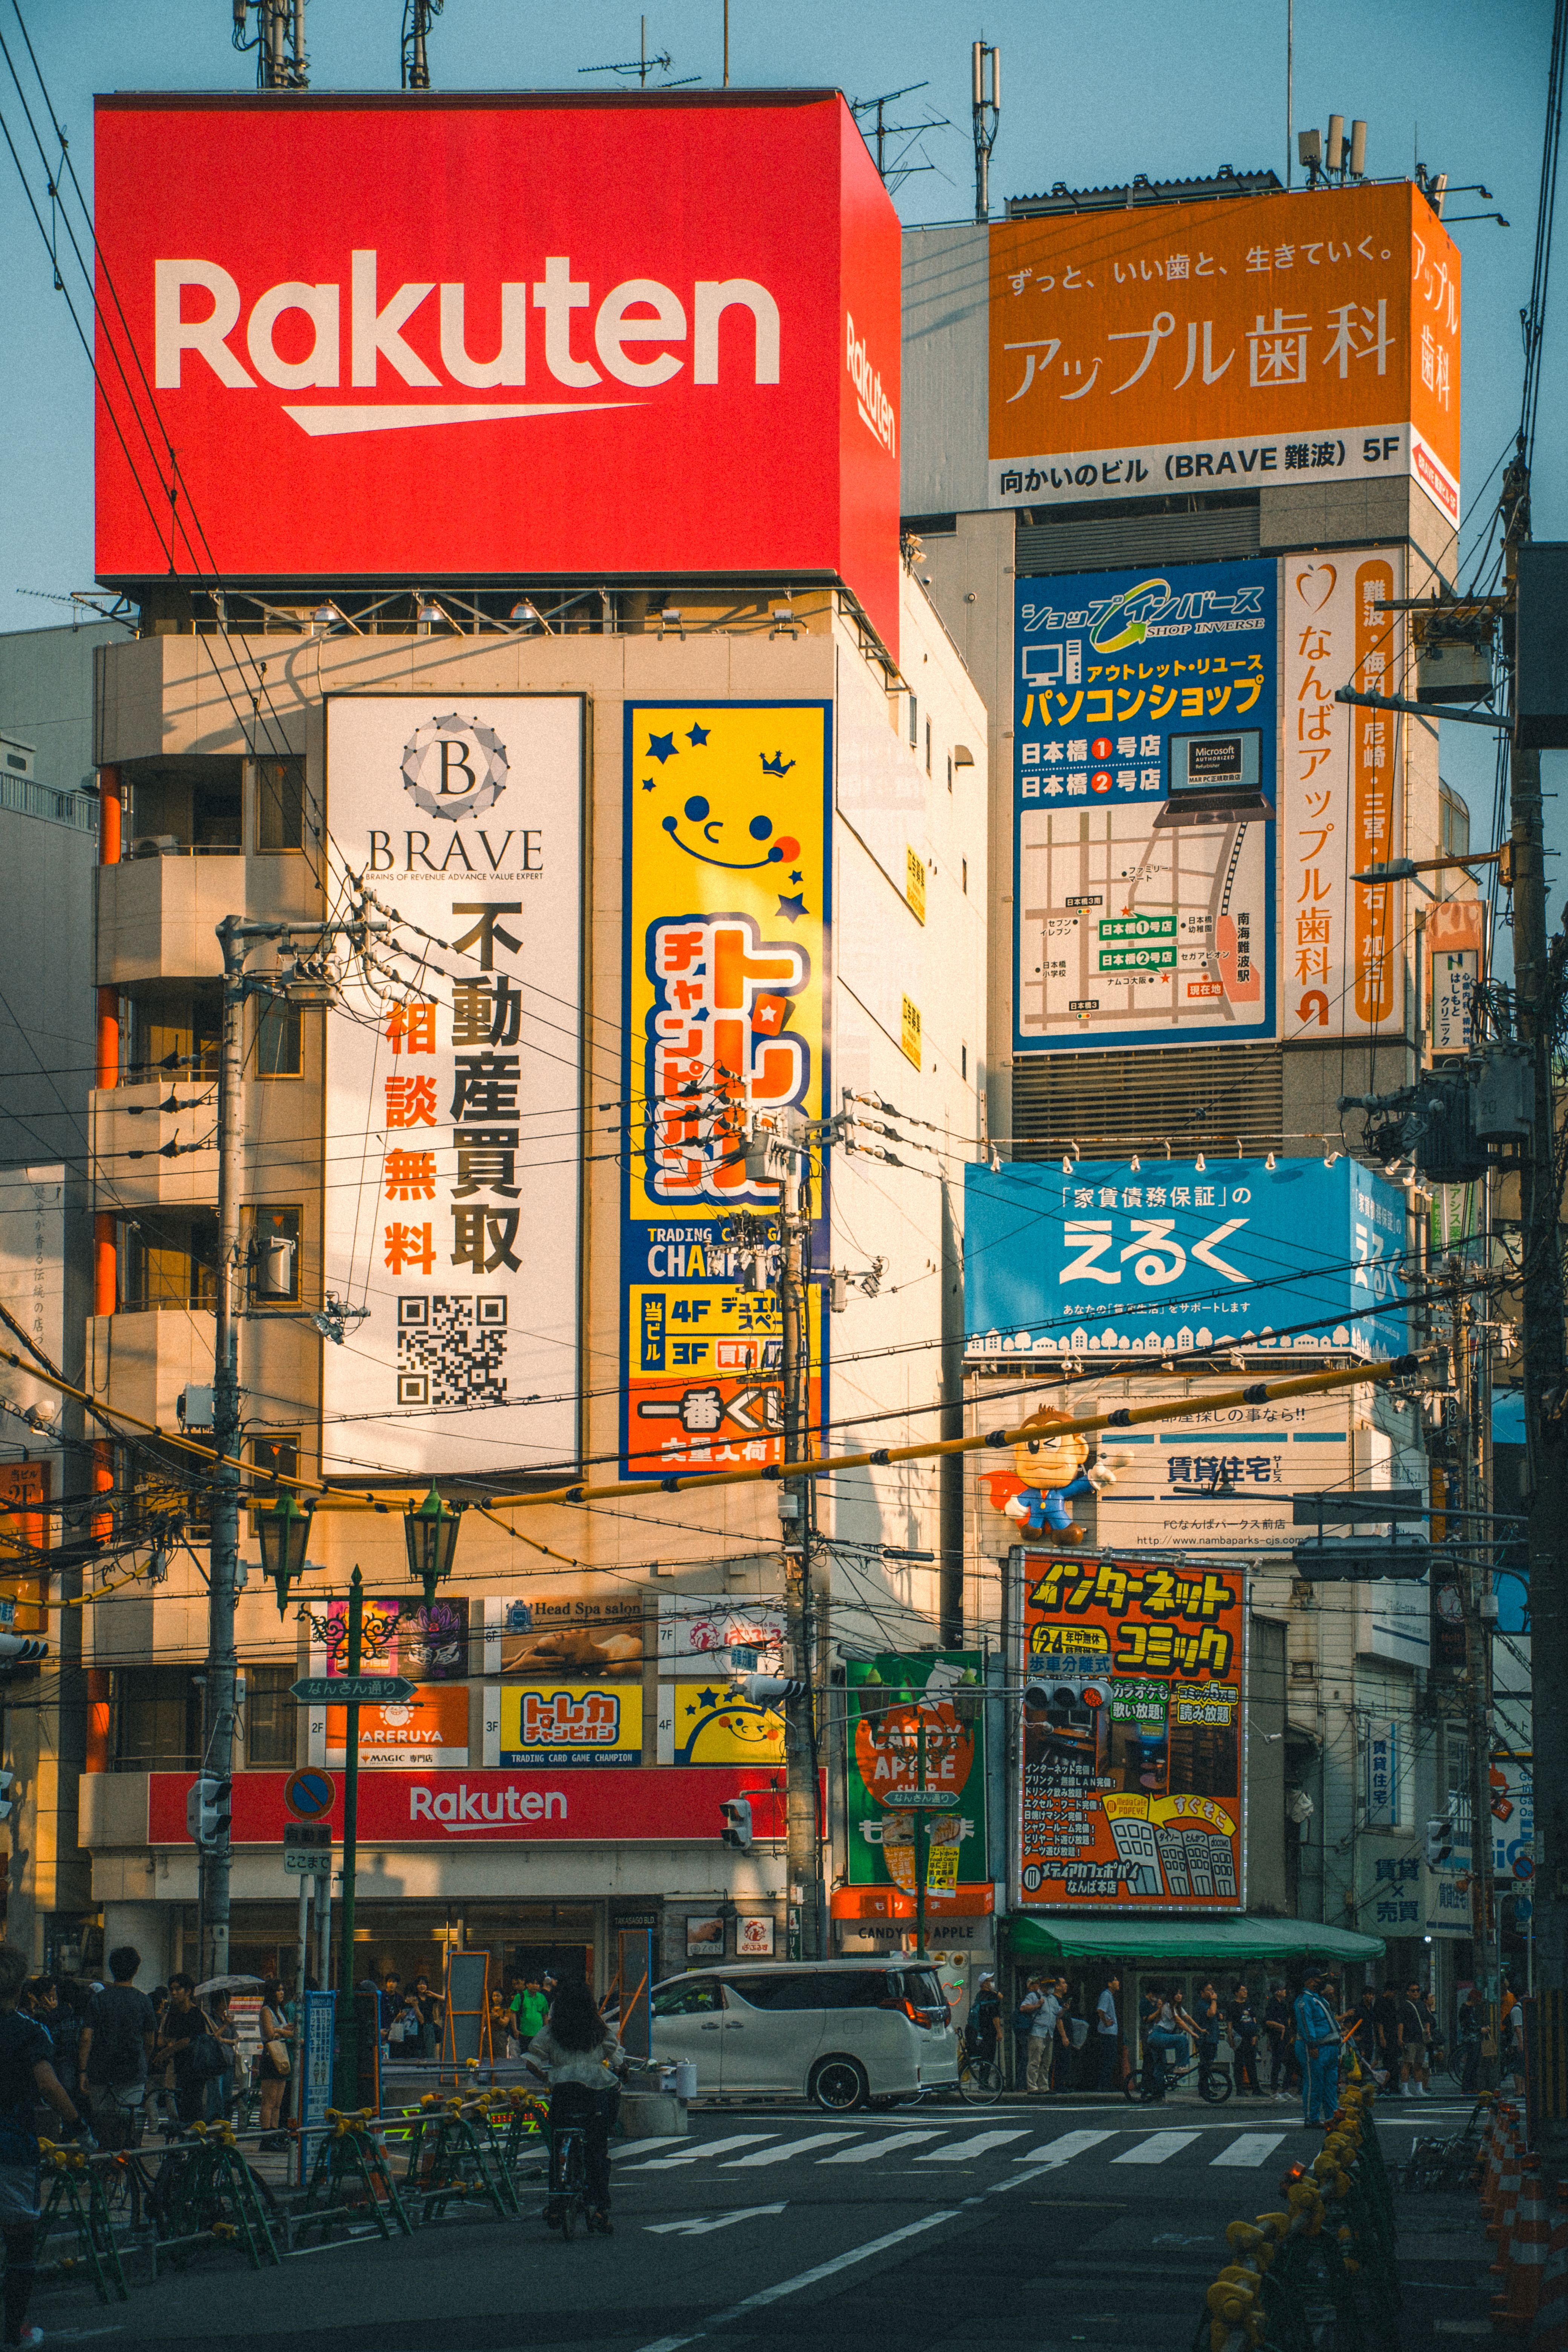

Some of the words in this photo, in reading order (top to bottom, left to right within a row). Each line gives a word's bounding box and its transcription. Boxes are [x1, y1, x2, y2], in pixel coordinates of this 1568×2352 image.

[1008, 234, 1391, 296] ずっと、いい歯と、生きていく。
[1413, 231, 1458, 335] アップル
[155, 249, 779, 389] Rakuten
[1004, 299, 1396, 403] アップル歯科
[1421, 325, 1450, 412] 歯科
[845, 311, 896, 459] Rakuten
[1000, 459, 1148, 495] 向かいのビル
[1363, 437, 1400, 462] 5F
[1021, 586, 1265, 632] ショップインバース
[1146, 622, 1191, 638] SHOP
[1194, 618, 1265, 634] INVERSE
[1087, 654, 1263, 683] アウトレット・リユース
[1021, 674, 1265, 728] パソコンショップ
[1195, 745, 1235, 756] Microsoft
[435, 740, 476, 795] B
[1294, 625, 1335, 985] なんばアップル歯科
[366, 829, 544, 871] BRAVE
[1129, 865, 1169, 874] ファミリー
[1047, 918, 1071, 927] セブン
[1188, 916, 1213, 925] 日本橋
[1188, 925, 1213, 933] 幼稚園
[1040, 928, 1071, 936] イレブン
[1237, 913, 1250, 983] 南海難波駅
[1043, 961, 1066, 969] 日本橋
[1043, 969, 1066, 978] 小学校
[1107, 976, 1147, 986] ナムコ大阪
[1190, 984, 1221, 995] 現在地
[1450, 973, 1461, 1017] はしもと
[1441, 997, 1450, 1046] クリニック
[449, 902, 524, 1274] 不動産買取
[384, 1001, 438, 1275] 相談無料
[1062, 1186, 1252, 1209] 「家賃債務保証」の
[648, 1228, 712, 1242] TRADING
[1058, 1218, 1256, 1286] えるく
[671, 1300, 711, 1322] 4F
[645, 1301, 662, 1360] 当ビル
[672, 1343, 709, 1364] 3F
[719, 1344, 755, 1364] 買取
[1152, 1408, 1305, 1424] 屋探しの事なら!!
[11, 1469, 37, 1482] 当ビル
[1167, 1455, 1271, 1483] 賃貸住宅
[1273, 1455, 1282, 1483] サービス
[1164, 1519, 1286, 1530] FCなんばパークス前店
[1031, 1563, 1230, 1615] インターネット
[535, 1602, 571, 1615] Head
[575, 1602, 601, 1618] Spa
[605, 1602, 641, 1615] salon
[660, 1630, 673, 1640] 7F
[1066, 1631, 1100, 1645] 年中無休
[1116, 1625, 1228, 1671] コミック
[1029, 1655, 1110, 1673] 歩車分離式
[308, 1680, 397, 1695] なんさん通り
[1113, 1683, 1168, 1700] カラオケも
[527, 1697, 614, 1724] トレカ
[1112, 1702, 1164, 1720] 歌い放題!
[1179, 1704, 1230, 1723] 読み放題
[312, 1722, 324, 1733] 2F
[486, 1721, 499, 1732] 3F
[526, 1725, 614, 1740] チャンピオン
[659, 1720, 672, 1730] 4F
[868, 1724, 962, 1750] CANDY
[410, 1754, 433, 1762] 専門店
[511, 1754, 545, 1763] TRADING
[548, 1754, 568, 1763] CARD
[571, 1754, 591, 1762] GAME
[595, 1753, 633, 1762] CHAMPION
[1373, 1740, 1387, 1804] 賃貸住宅
[410, 1784, 568, 1821] Rakuten
[894, 1794, 950, 1804] なんさん通り
[1116, 1798, 1133, 1806] Media
[1118, 1807, 1145, 1815] POPEYE
[1174, 1796, 1227, 1829] すぐそこ
[286, 1855, 329, 1868] ここまで
[1376, 1858, 1420, 1882] 賃貸
[1041, 1863, 1139, 1880] メディアカフェポパイ
[1067, 1879, 1117, 1894] なんば本店
[614, 1917, 643, 1925] TAKASAGO
[1377, 1900, 1419, 1923] 売買
[858, 1926, 904, 1939] CANDY
[934, 1926, 974, 1939] APPLE
